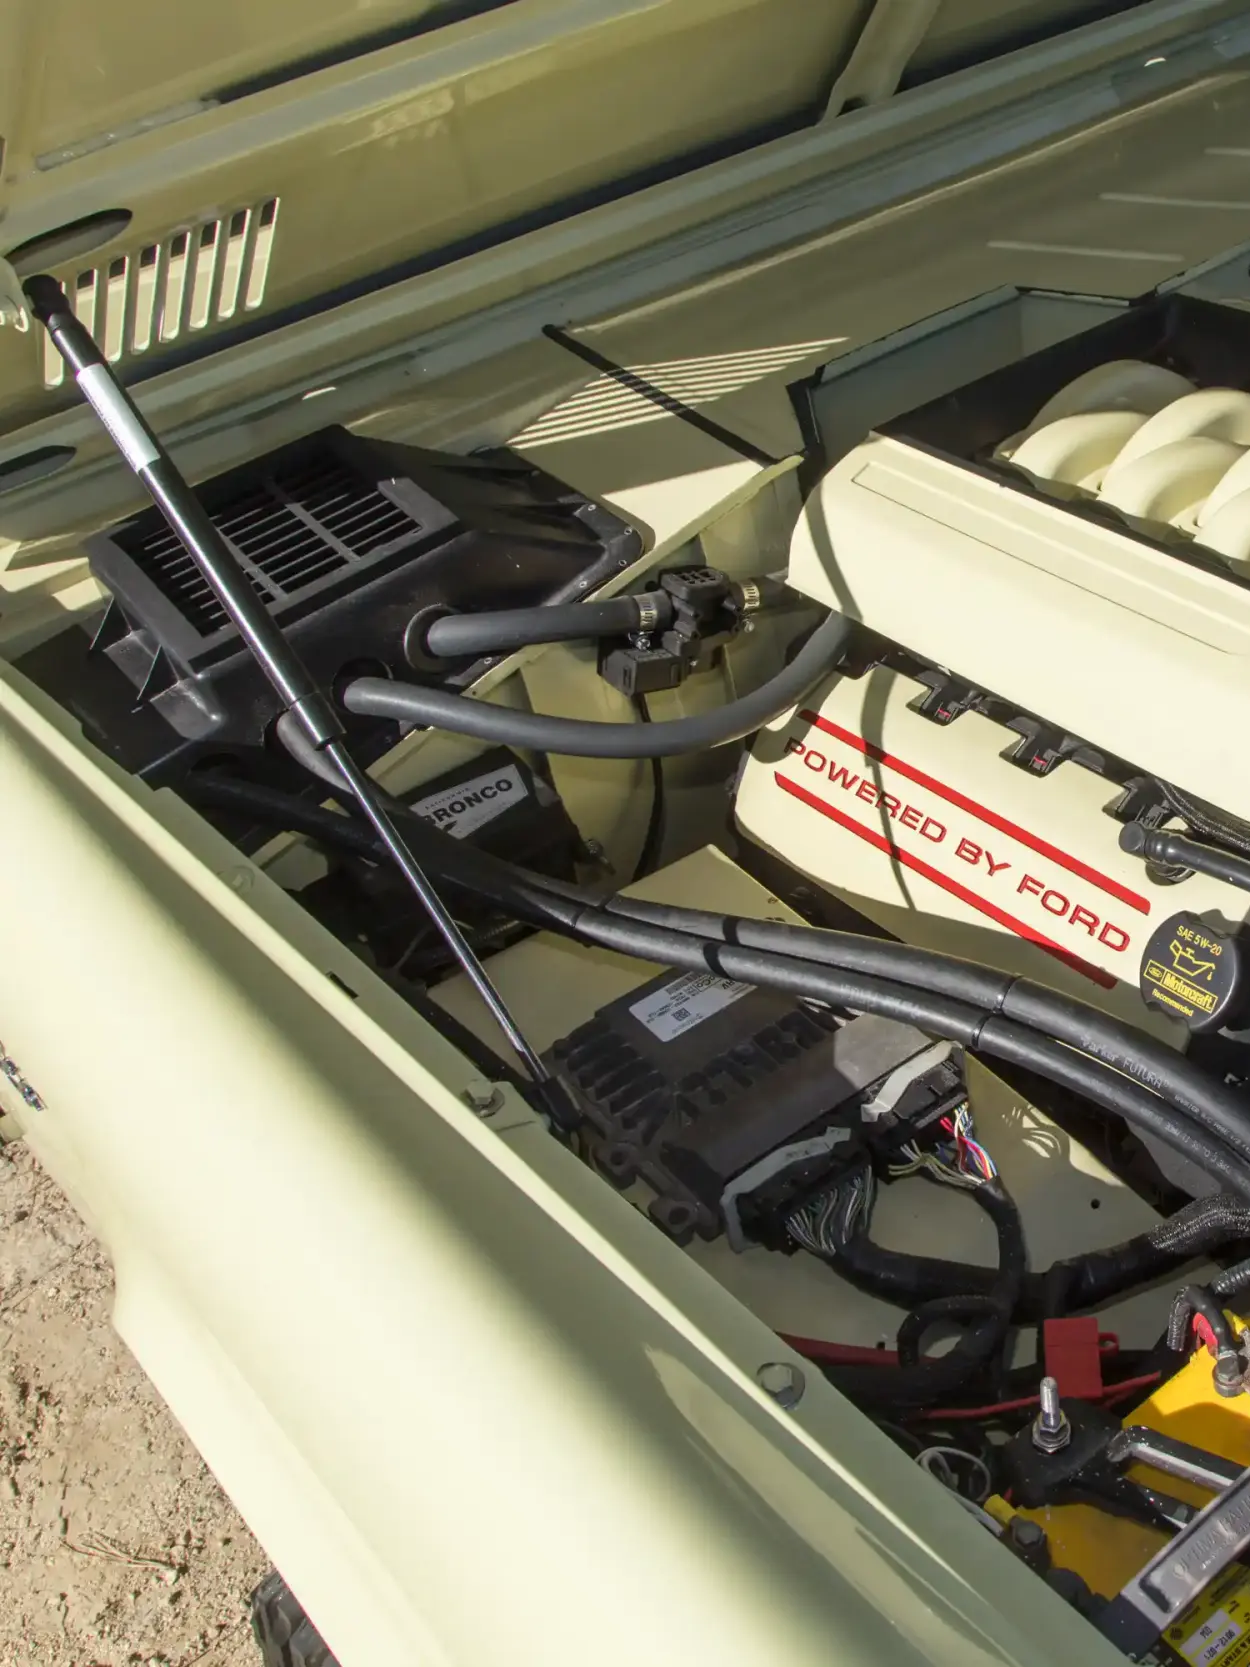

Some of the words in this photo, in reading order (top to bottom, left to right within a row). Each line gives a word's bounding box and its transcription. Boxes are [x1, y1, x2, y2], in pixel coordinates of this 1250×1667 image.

[784, 737, 948, 843] POWERED
[954, 837, 1011, 876] BY
[1017, 874, 1131, 952] FORD
[1176, 925, 1195, 942] SAE
[1194, 934, 1223, 957] 5W-20
[1152, 988, 1194, 1017] Recommended
[1163, 972, 1213, 1011] Motorcraft
